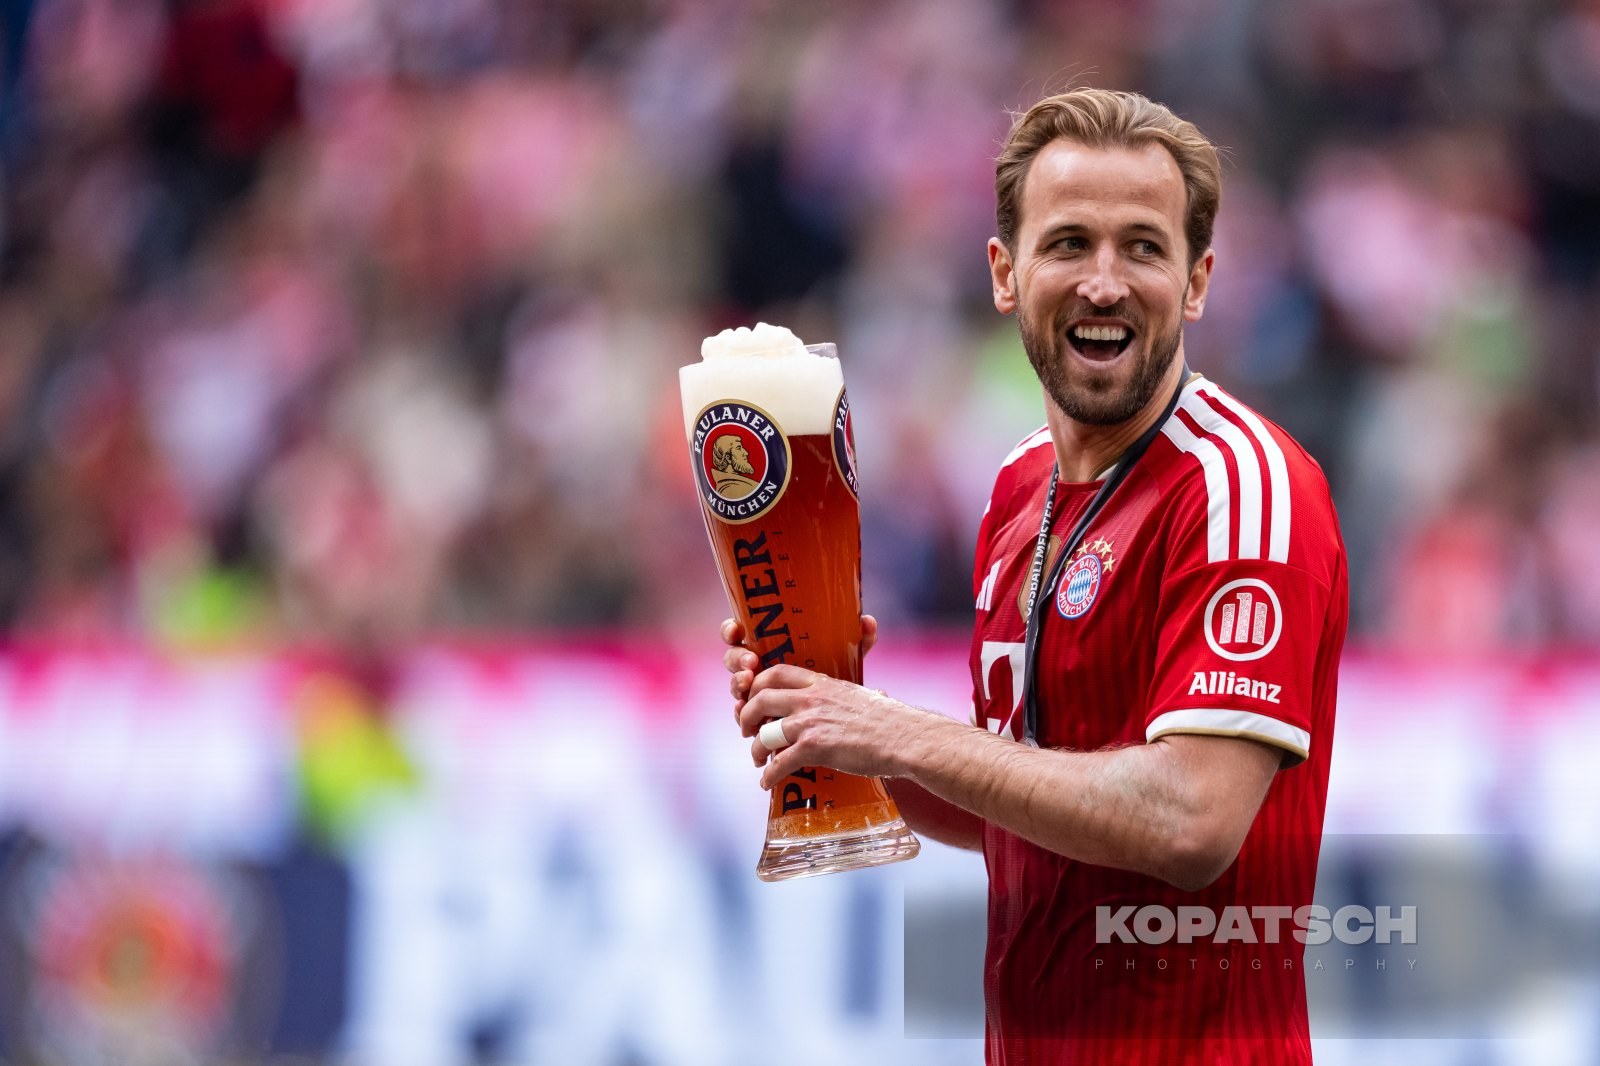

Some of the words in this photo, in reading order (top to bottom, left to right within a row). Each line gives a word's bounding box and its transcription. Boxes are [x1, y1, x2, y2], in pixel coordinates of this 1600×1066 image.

[694, 406, 775, 454] PAULANER
[707, 480, 778, 516] MÜNCHEN
[1066, 567, 1077, 582] FC
[1079, 558, 1098, 583] BAYERN
[1187, 671, 1282, 704] Allianz
